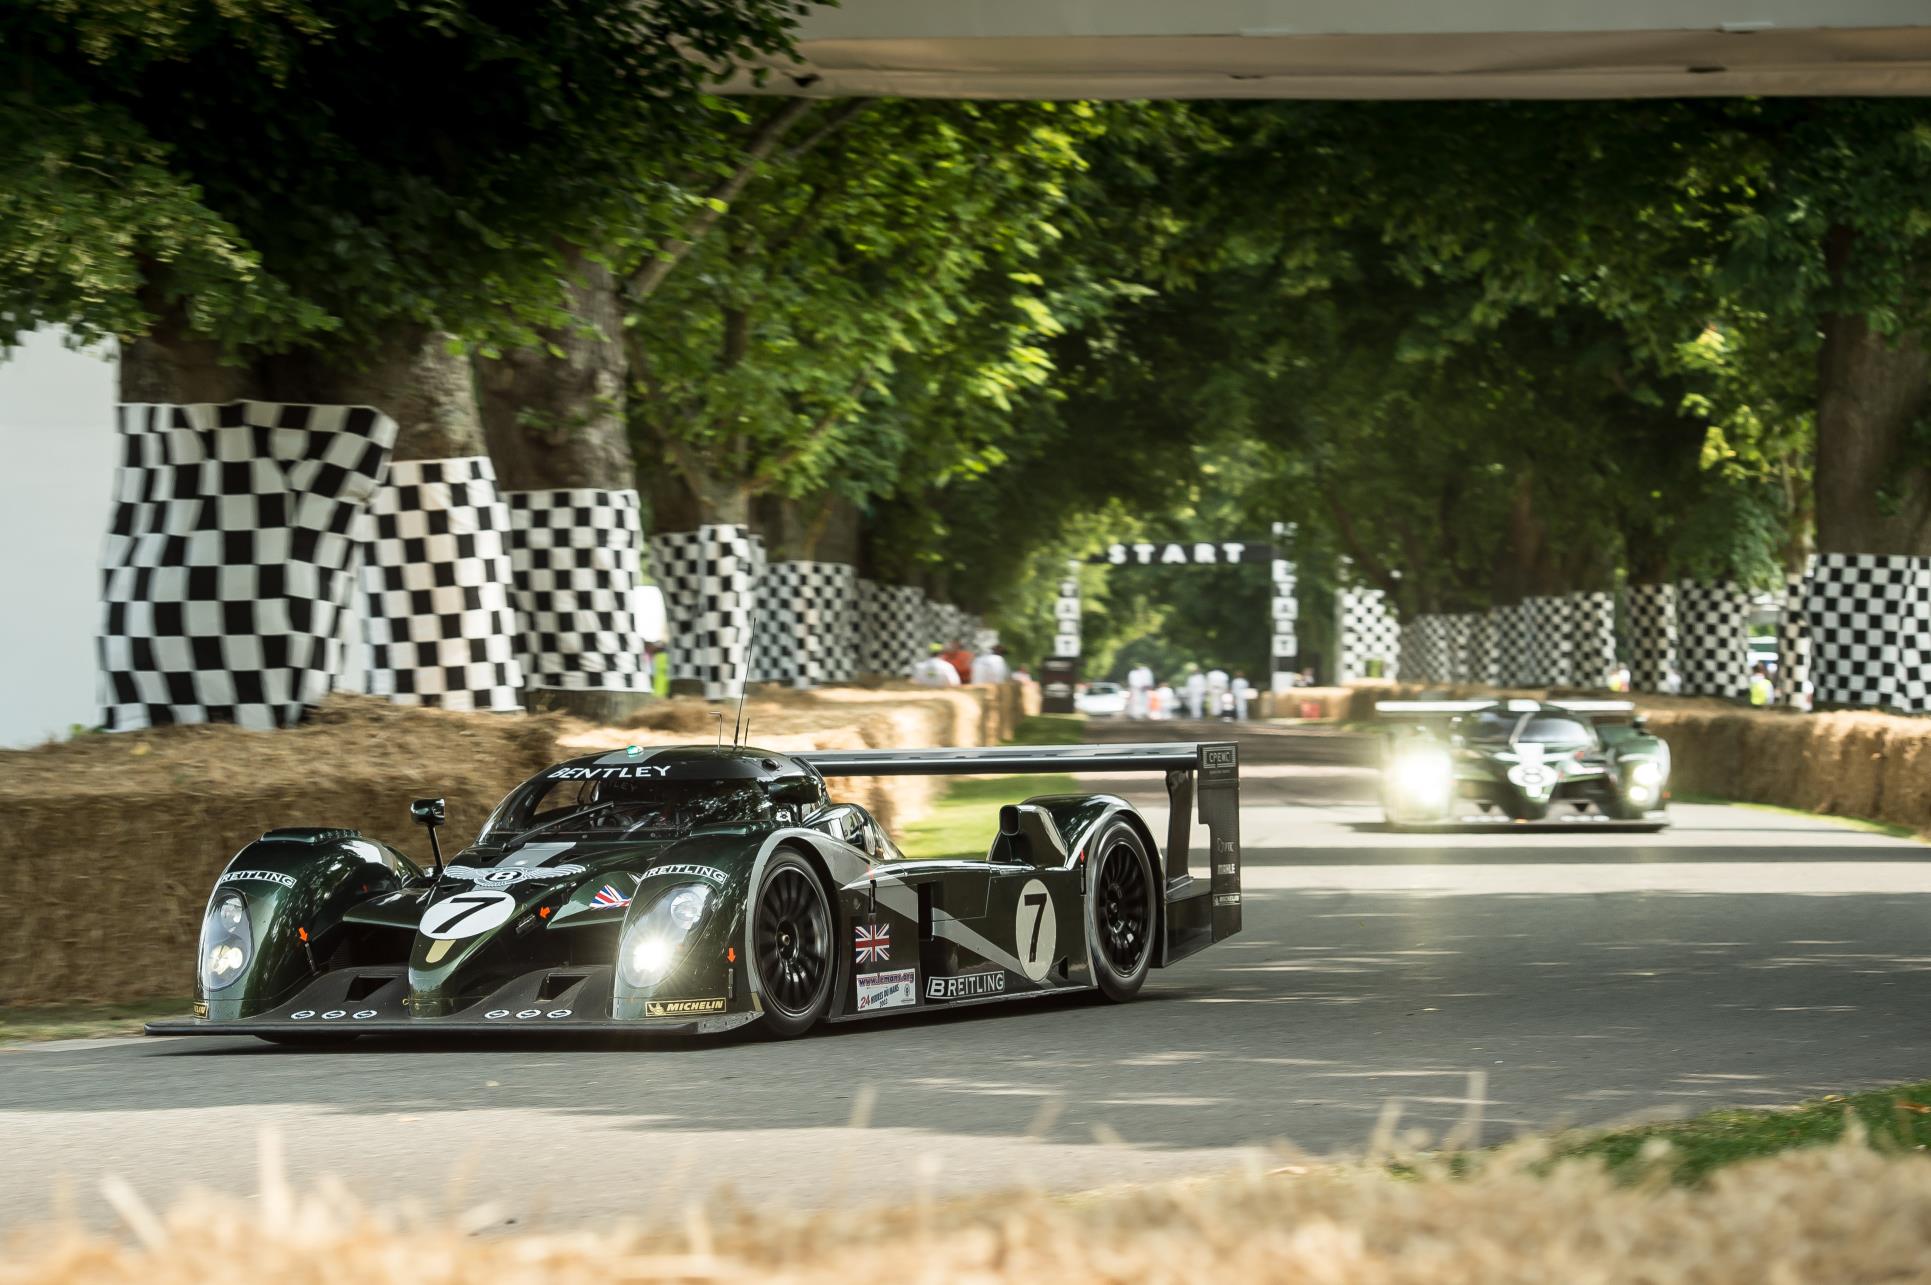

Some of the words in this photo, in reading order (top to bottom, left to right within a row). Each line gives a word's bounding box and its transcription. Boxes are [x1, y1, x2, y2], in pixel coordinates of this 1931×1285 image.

[1108, 543, 1245, 564] START
[547, 765, 671, 779] BENTLEY
[489, 871, 514, 881] B
[431, 897, 507, 934] 7
[1024, 893, 1047, 963] 7
[929, 974, 1004, 996] BREITLING
[666, 1000, 723, 1012] MICHELIN
[860, 994, 870, 1009] 24
